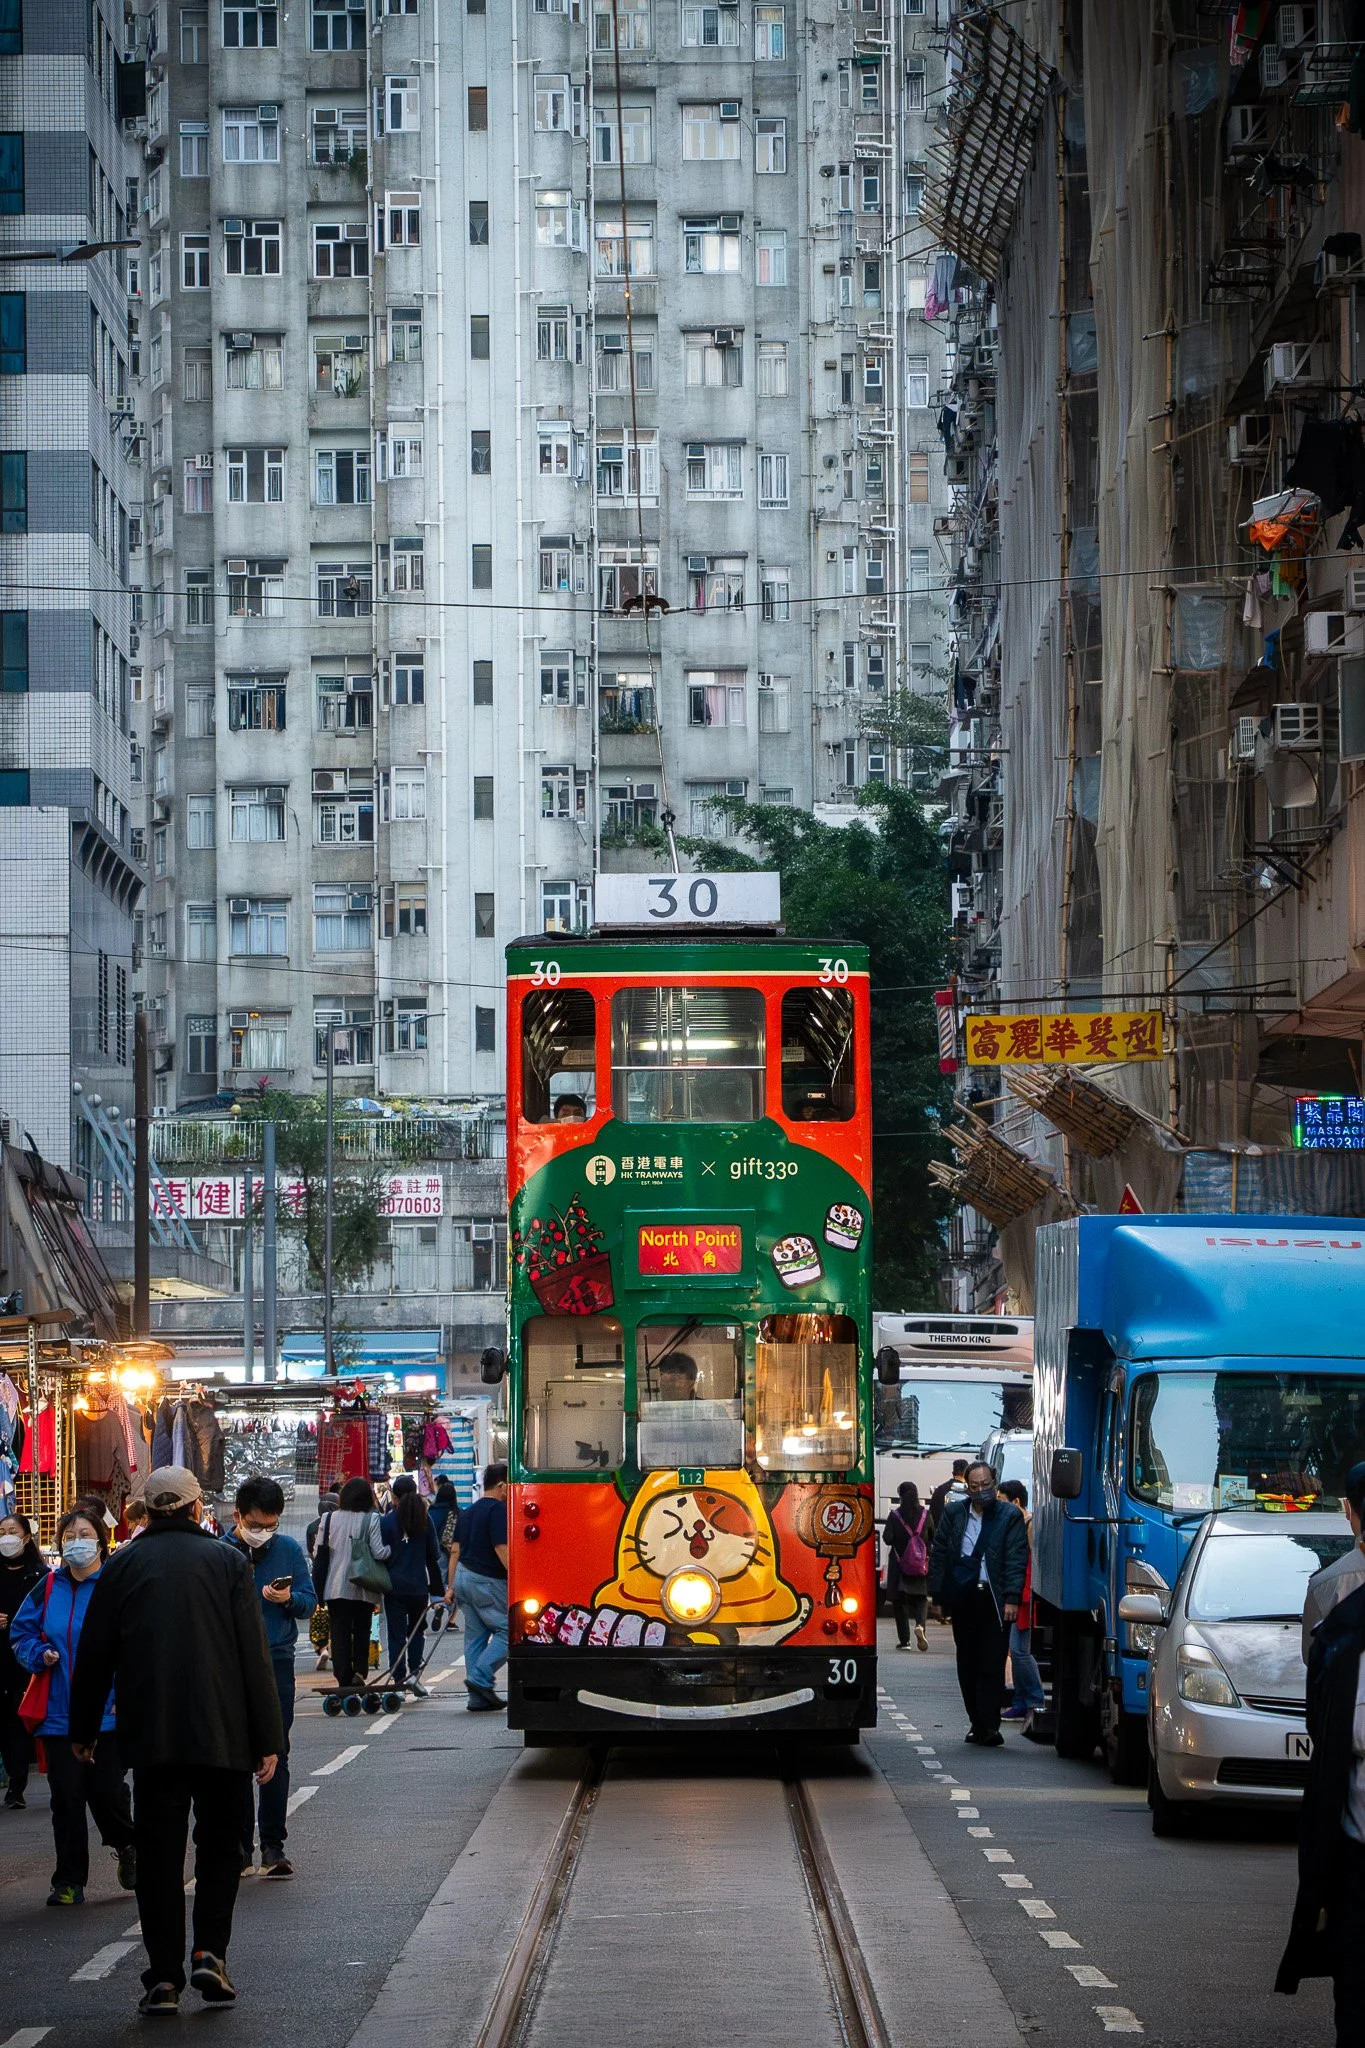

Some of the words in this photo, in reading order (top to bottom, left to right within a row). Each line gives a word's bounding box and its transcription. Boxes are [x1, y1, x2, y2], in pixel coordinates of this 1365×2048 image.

[648, 878, 718, 918] 30
[530, 960, 561, 986] 30
[818, 958, 849, 984] 30
[970, 1015, 1159, 1060] 富麗華髮型
[621, 1156, 684, 1170] 香港電車
[730, 1157, 799, 1180] gift330
[620, 1171, 633, 1179] HK
[635, 1171, 684, 1179] TRAMWAYS
[641, 1230, 689, 1247] North
[695, 1230, 738, 1247] Point
[1206, 1237, 1362, 1250] ISUZU
[662, 1249, 717, 1268] 北角
[928, 1334, 968, 1344] THERMO
[969, 1335, 991, 1344] KING
[680, 1472, 702, 1484] 112
[827, 1504, 853, 1531] 財
[828, 1658, 857, 1685] 30
